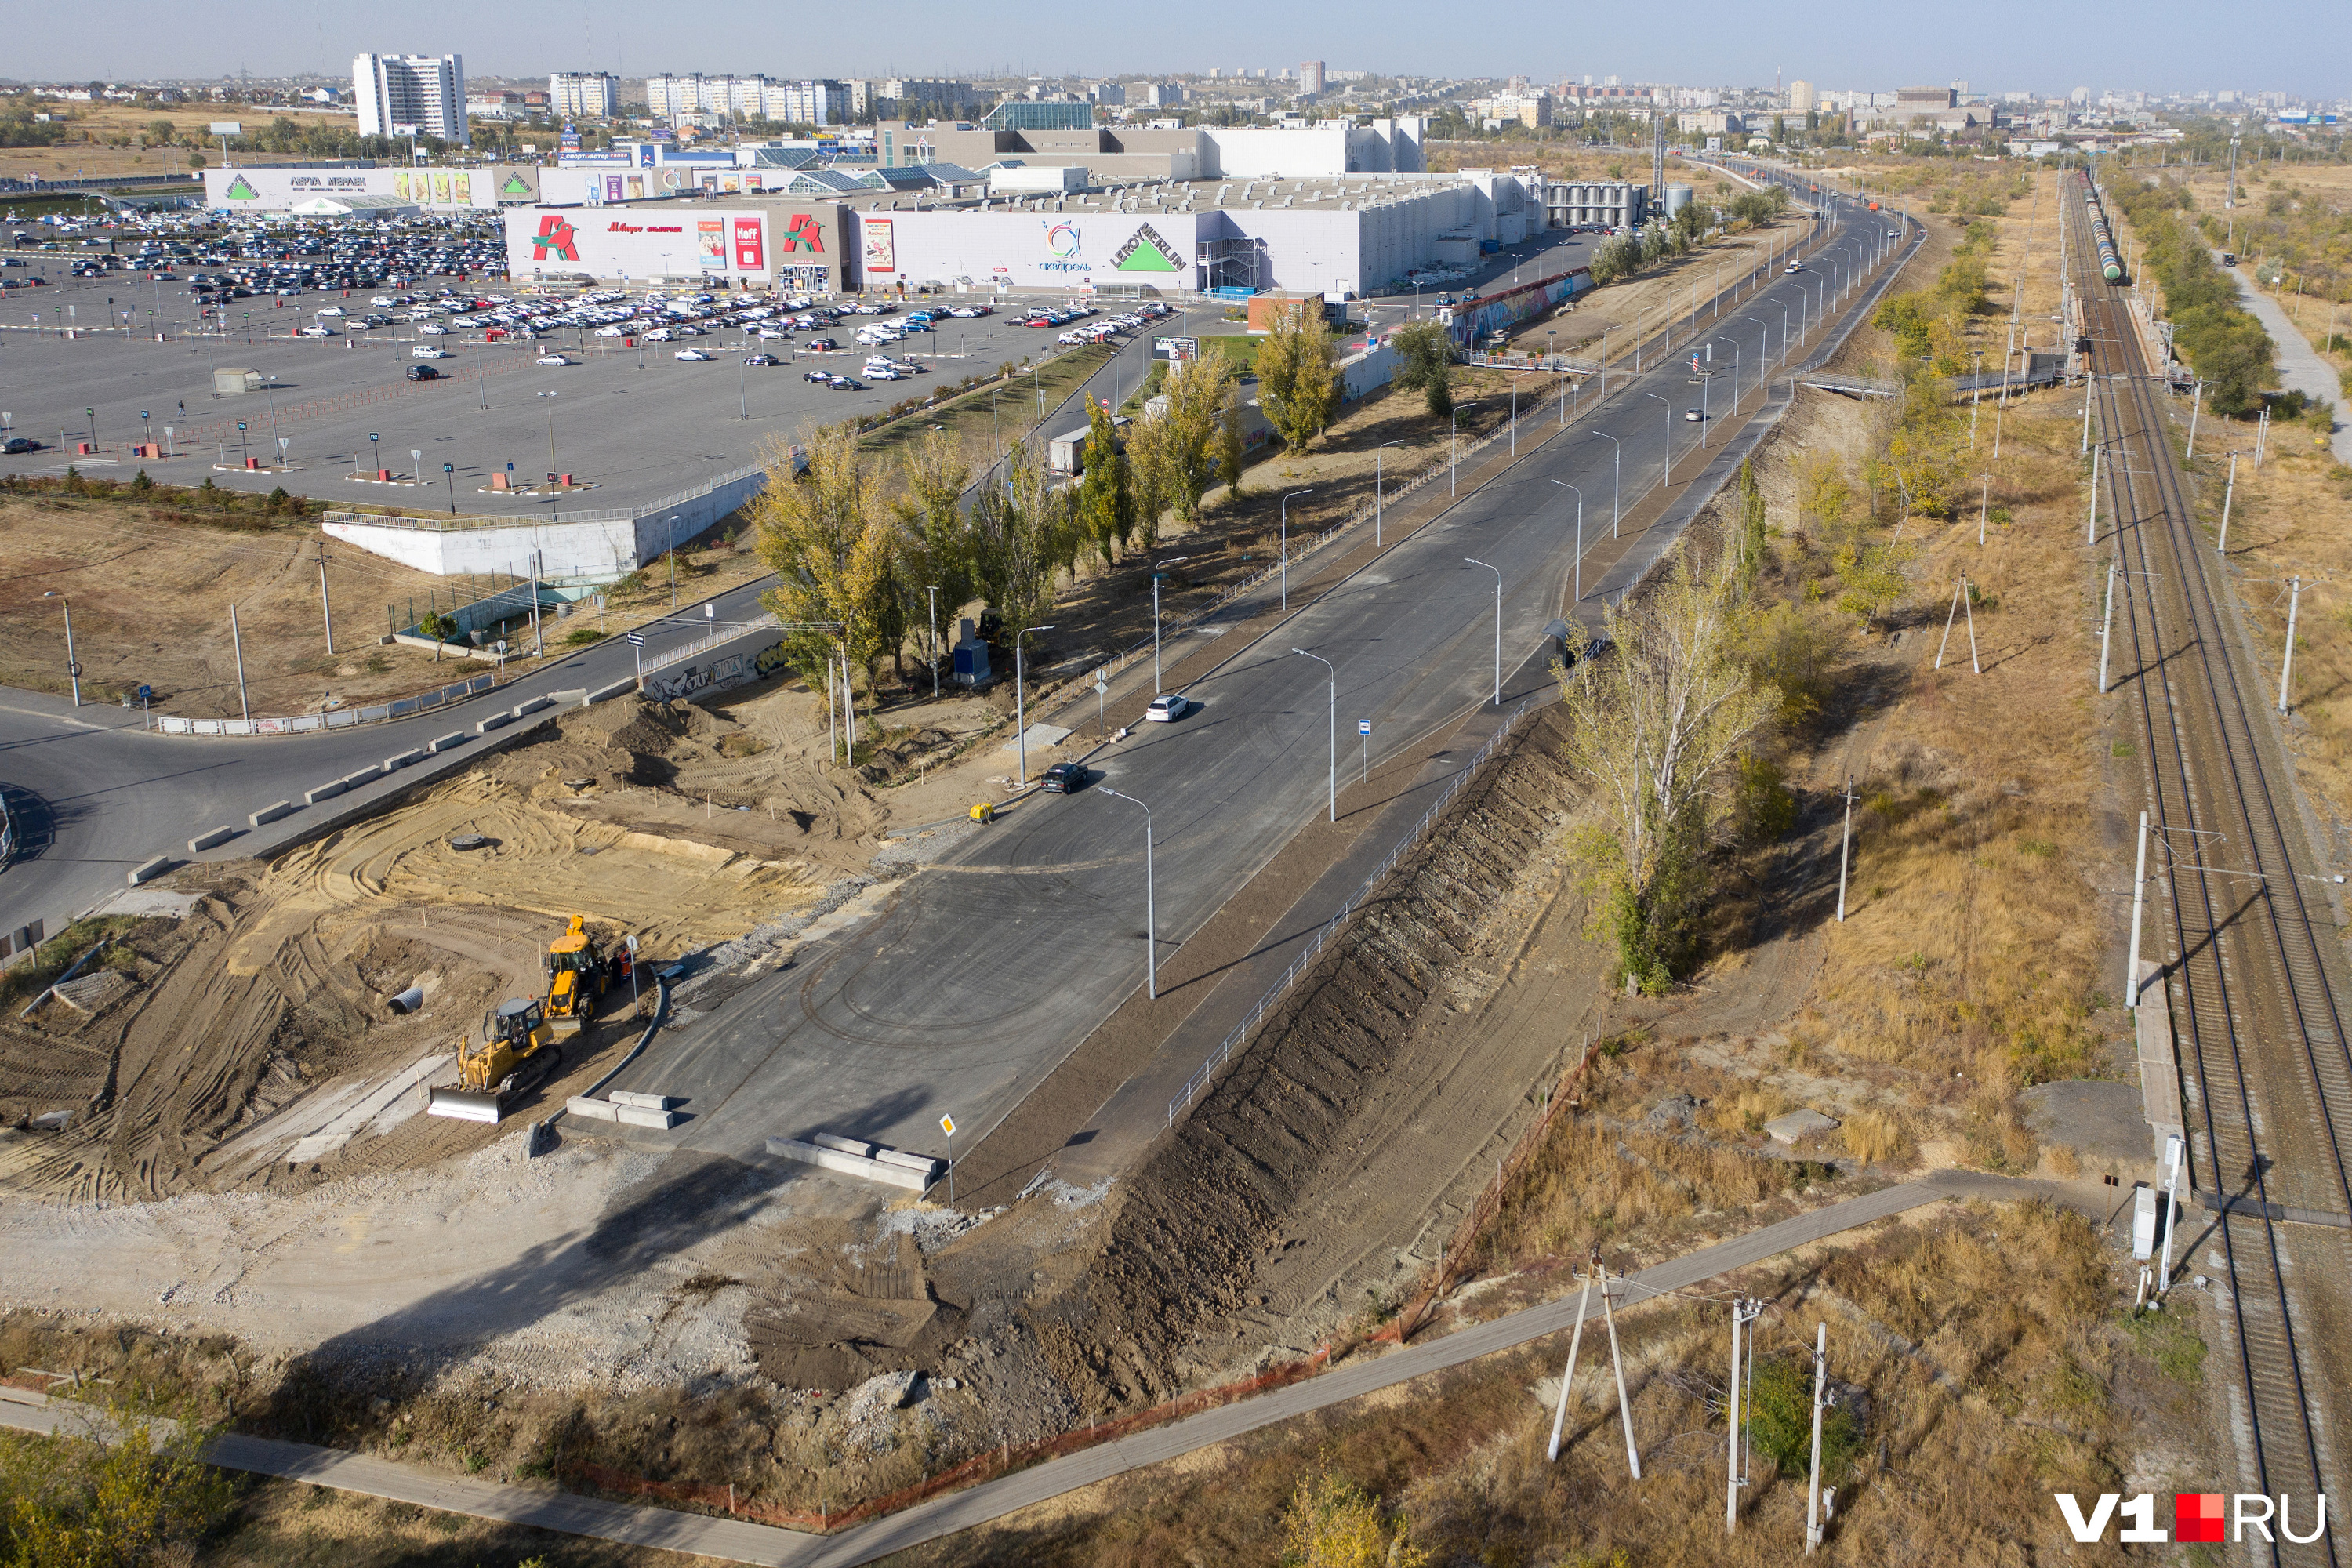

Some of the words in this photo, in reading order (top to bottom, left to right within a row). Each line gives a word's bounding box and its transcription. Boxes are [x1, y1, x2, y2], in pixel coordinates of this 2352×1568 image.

[290, 176, 321, 186] ЛЕРУА
[327, 176, 366, 186] МЕРЛЕН
[737, 227, 757, 240] Hoff
[1109, 229, 1145, 268] LEROY
[1138, 221, 1187, 271] MERLIN
[1039, 261, 1091, 273] акварель
